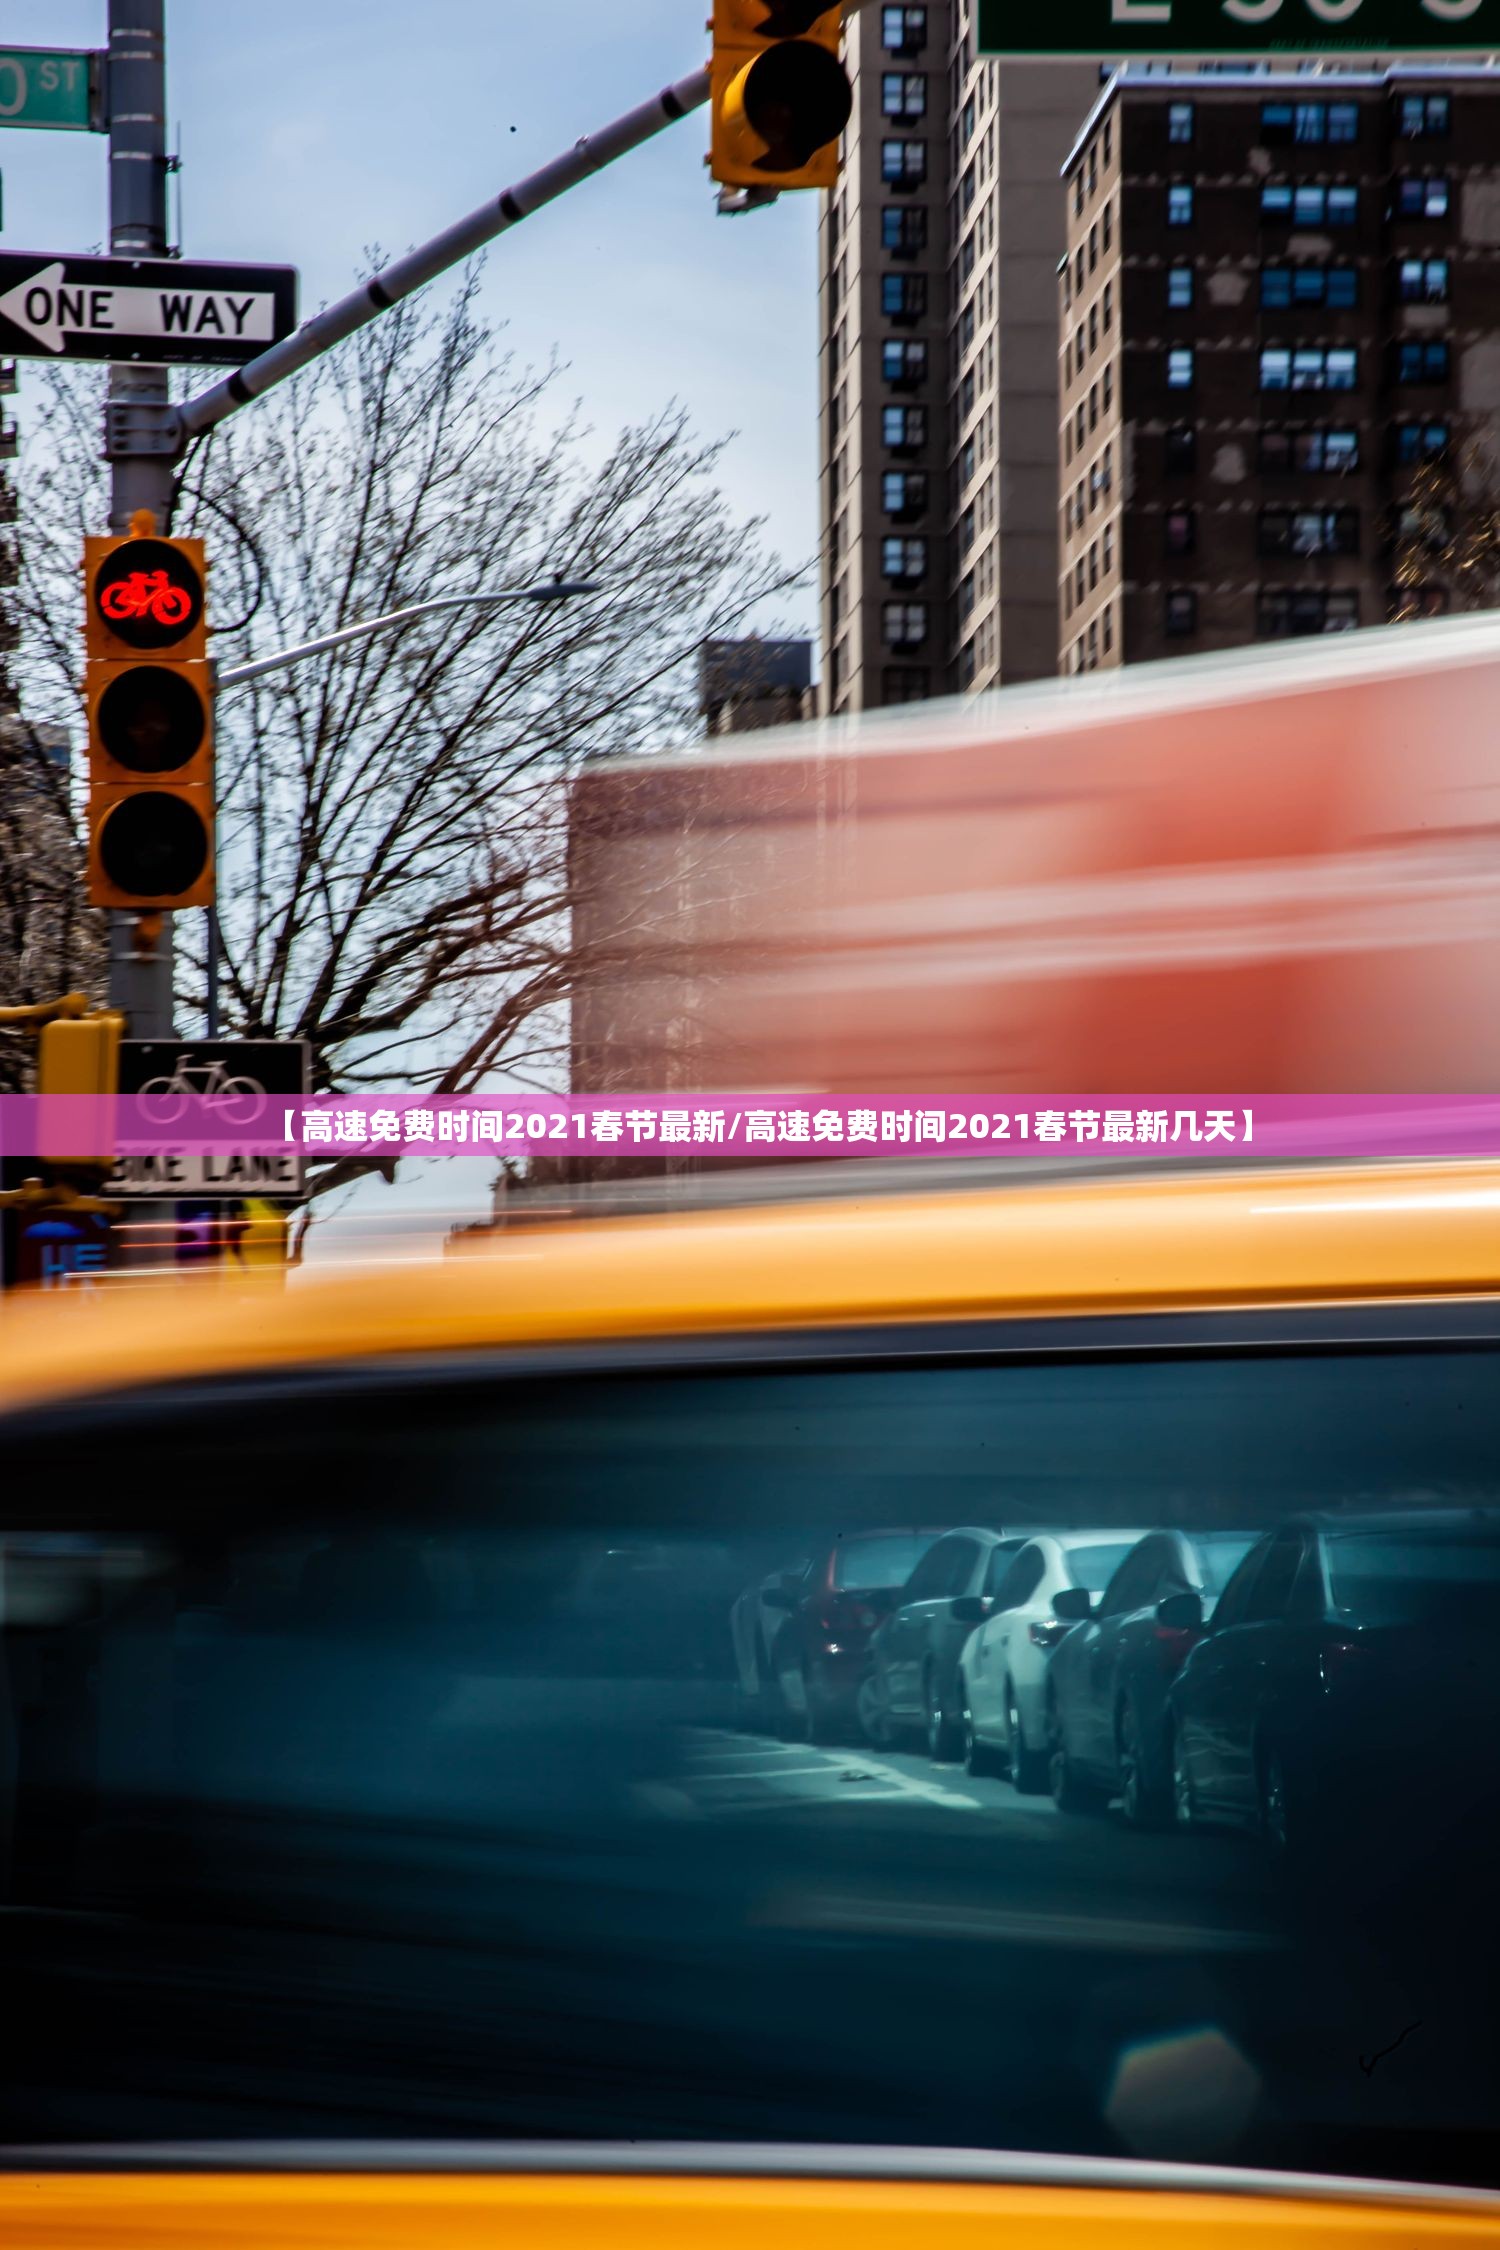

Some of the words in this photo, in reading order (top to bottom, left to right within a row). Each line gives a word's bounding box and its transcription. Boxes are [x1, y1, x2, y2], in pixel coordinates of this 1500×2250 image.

[39, 60, 81, 93] ST
[24, 286, 114, 329] ONE
[160, 293, 255, 335] WAY
[203, 1147, 296, 1182] LANE
